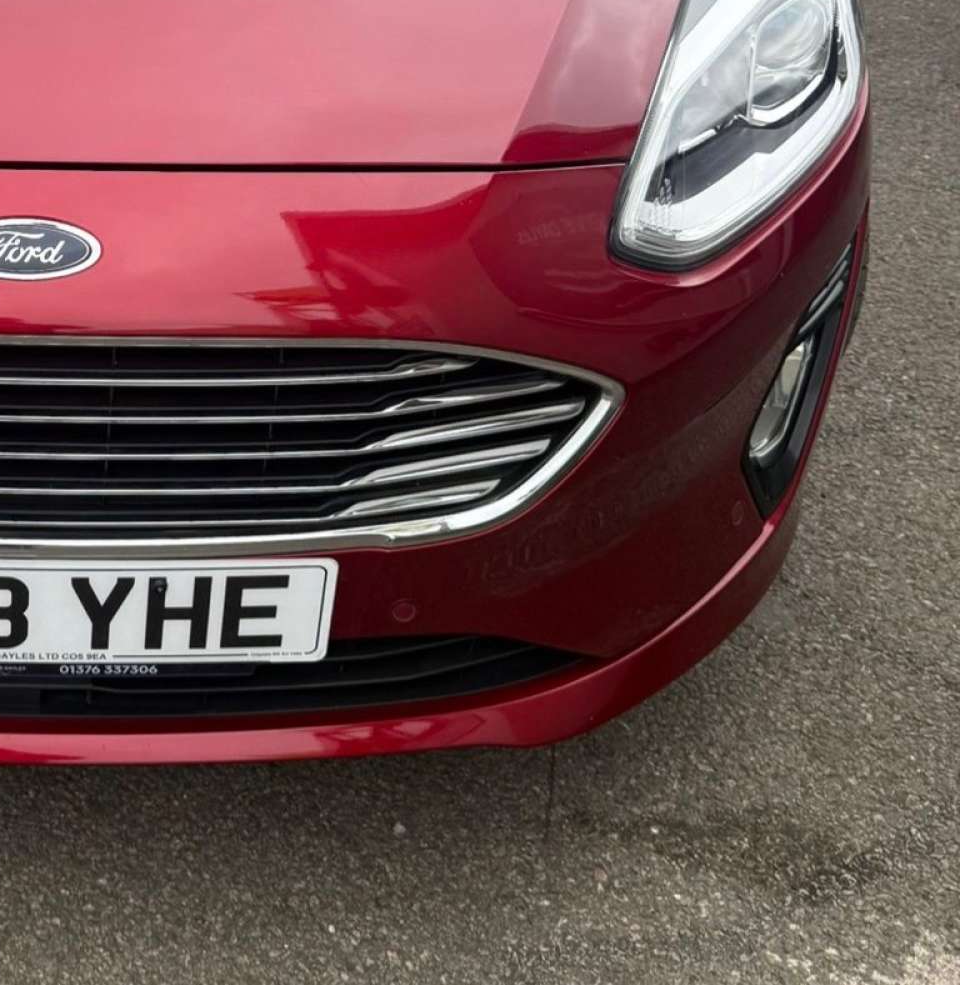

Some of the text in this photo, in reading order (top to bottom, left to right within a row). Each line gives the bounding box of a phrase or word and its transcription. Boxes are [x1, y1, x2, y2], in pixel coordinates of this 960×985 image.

[71, 574, 290, 650] YHE
[59, 664, 158, 675] 01376 337306
